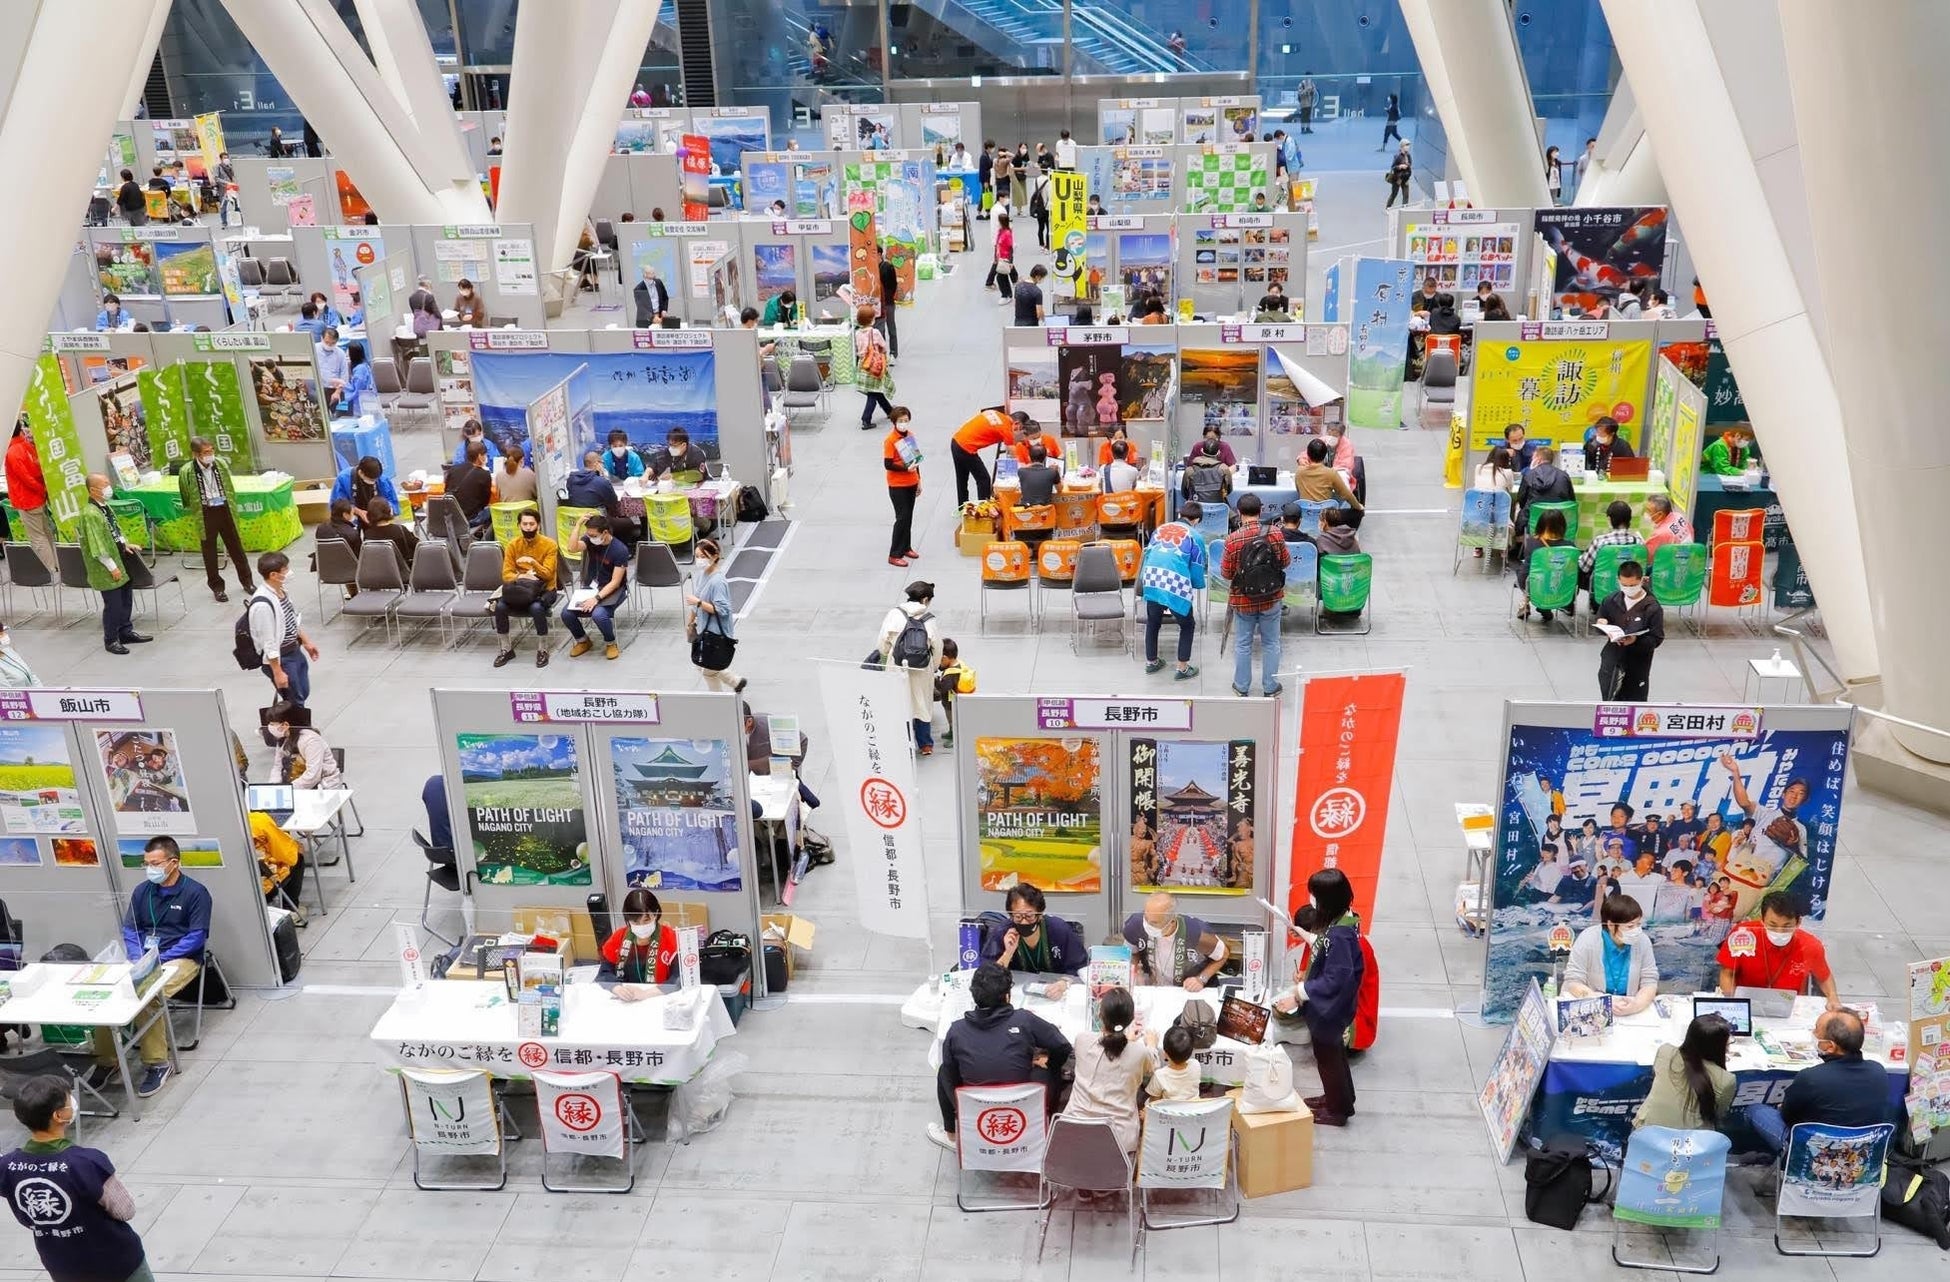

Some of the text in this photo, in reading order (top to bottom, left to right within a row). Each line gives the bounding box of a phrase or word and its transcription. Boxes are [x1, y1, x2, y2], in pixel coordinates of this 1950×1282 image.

[1582, 213, 1623, 224] 小千谷市
[349, 229, 370, 238] 金沢市
[1083, 332, 1113, 343] 茅野市
[60, 698, 112, 714] 飯山市
[583, 697, 615, 708] 長野市
[11, 710, 24, 719] 12
[1041, 707, 1069, 718] 長野県
[1104, 706, 1159, 722] 長野市
[1050, 719, 1061, 728] 10
[1599, 716, 1629, 727] 長野県
[1667, 714, 1726, 731] 宮田村
[859, 694, 883, 774] ながのご縁を
[1132, 743, 1157, 811] 御開帳
[1229, 745, 1253, 814] 善光寺
[1562, 751, 1779, 830] 宮田村
[869, 786, 901, 819] 縁
[476, 807, 573, 823] PATH OF LIGHT
[627, 811, 725, 829] PATH OF LIGHT
[987, 812, 1089, 828] PATH OF LIGHT
[478, 822, 533, 833] NAGANO CITY
[628, 827, 684, 838] NAGANO CITY
[988, 828, 1045, 838] NAGANO CITY
[882, 834, 902, 910] 信都・長野市
[399, 1041, 665, 1068] ながのご縁を 縁 信都・長野市
[563, 1101, 594, 1124] 縁
[986, 1114, 1018, 1138] 縁
[437, 1131, 471, 1140] 長野市
[8, 1161, 69, 1173] ながのご縁を
[1165, 1164, 1200, 1173] 長野市
[22, 1187, 64, 1219] 縁
